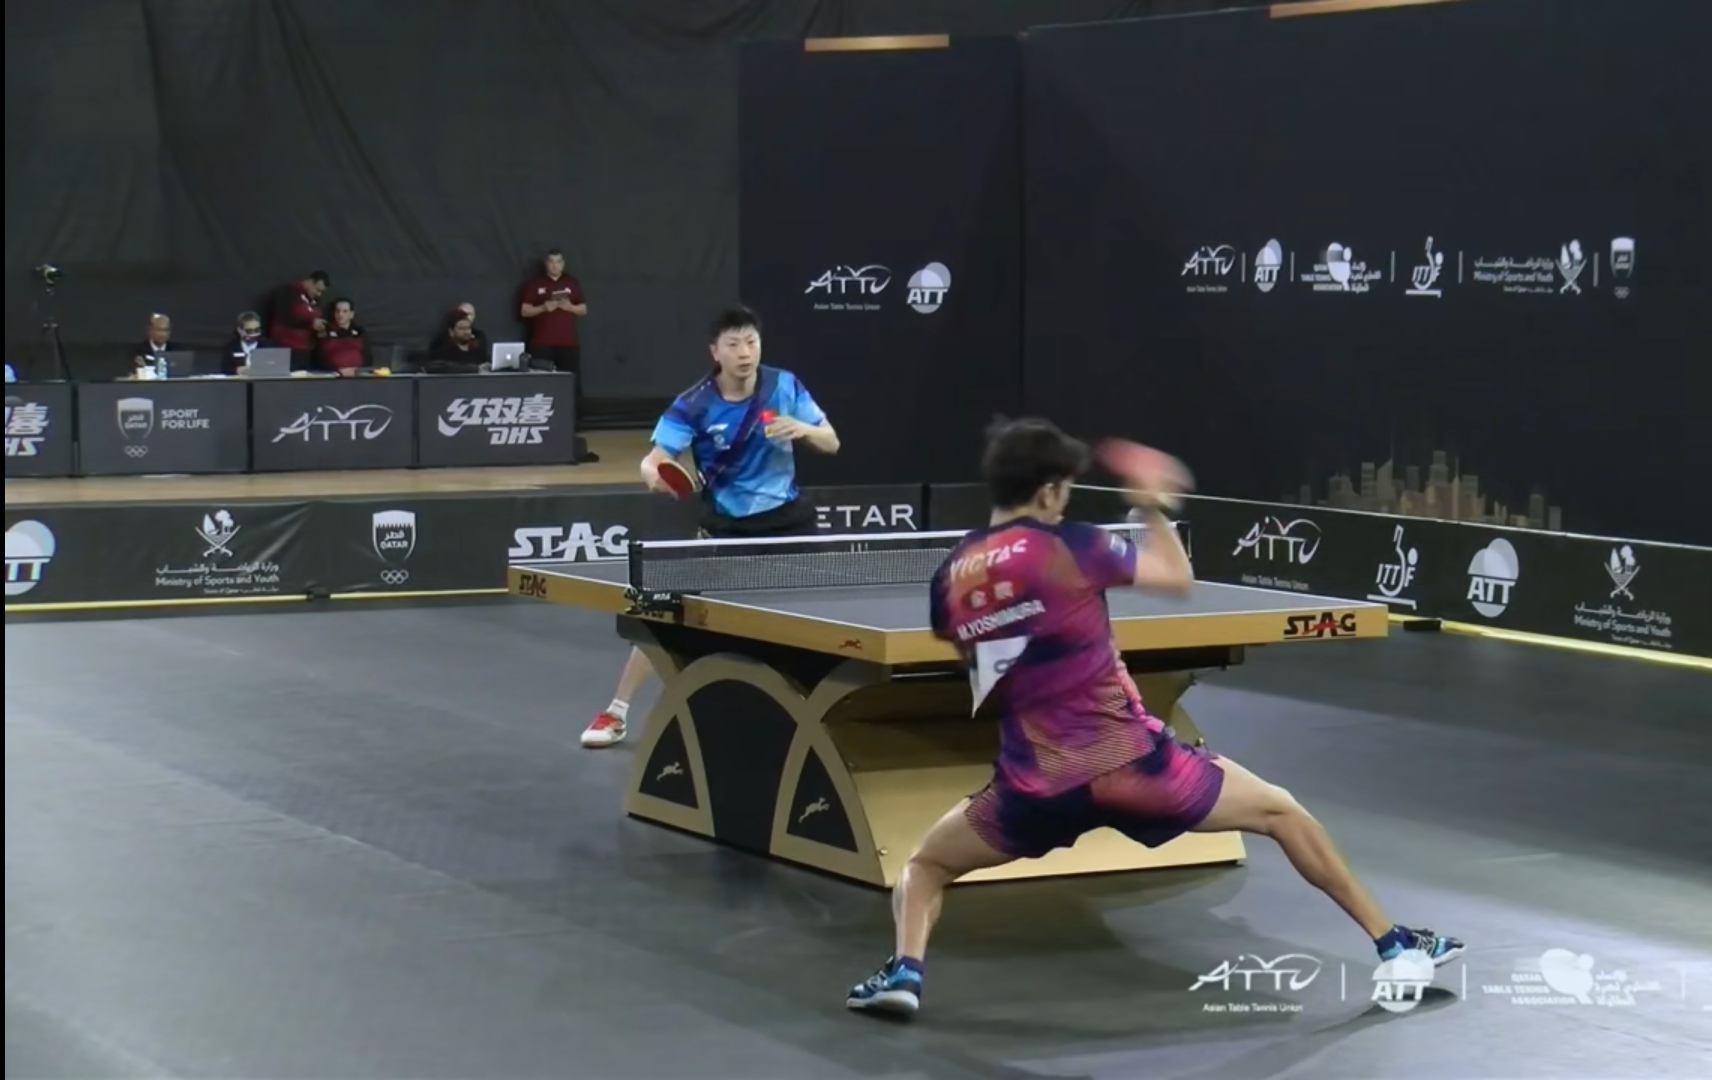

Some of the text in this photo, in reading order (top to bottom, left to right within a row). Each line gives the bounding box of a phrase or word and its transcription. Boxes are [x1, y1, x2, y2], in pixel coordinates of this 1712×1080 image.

[1254, 266, 1281, 283] ATT
[905, 288, 949, 305] ATT
[5, 401, 50, 435] 喜
[161, 408, 200, 420] SPORT
[161, 418, 210, 430] FOR LIFE
[487, 426, 550, 445] DHS
[380, 540, 409, 550] QATAR
[508, 522, 630, 562] STAG
[155, 573, 281, 589] Ministry of Sports and Youth
[518, 573, 548, 598] STAG
[1466, 575, 1517, 605] ATT
[1283, 611, 1357, 639] STAG
